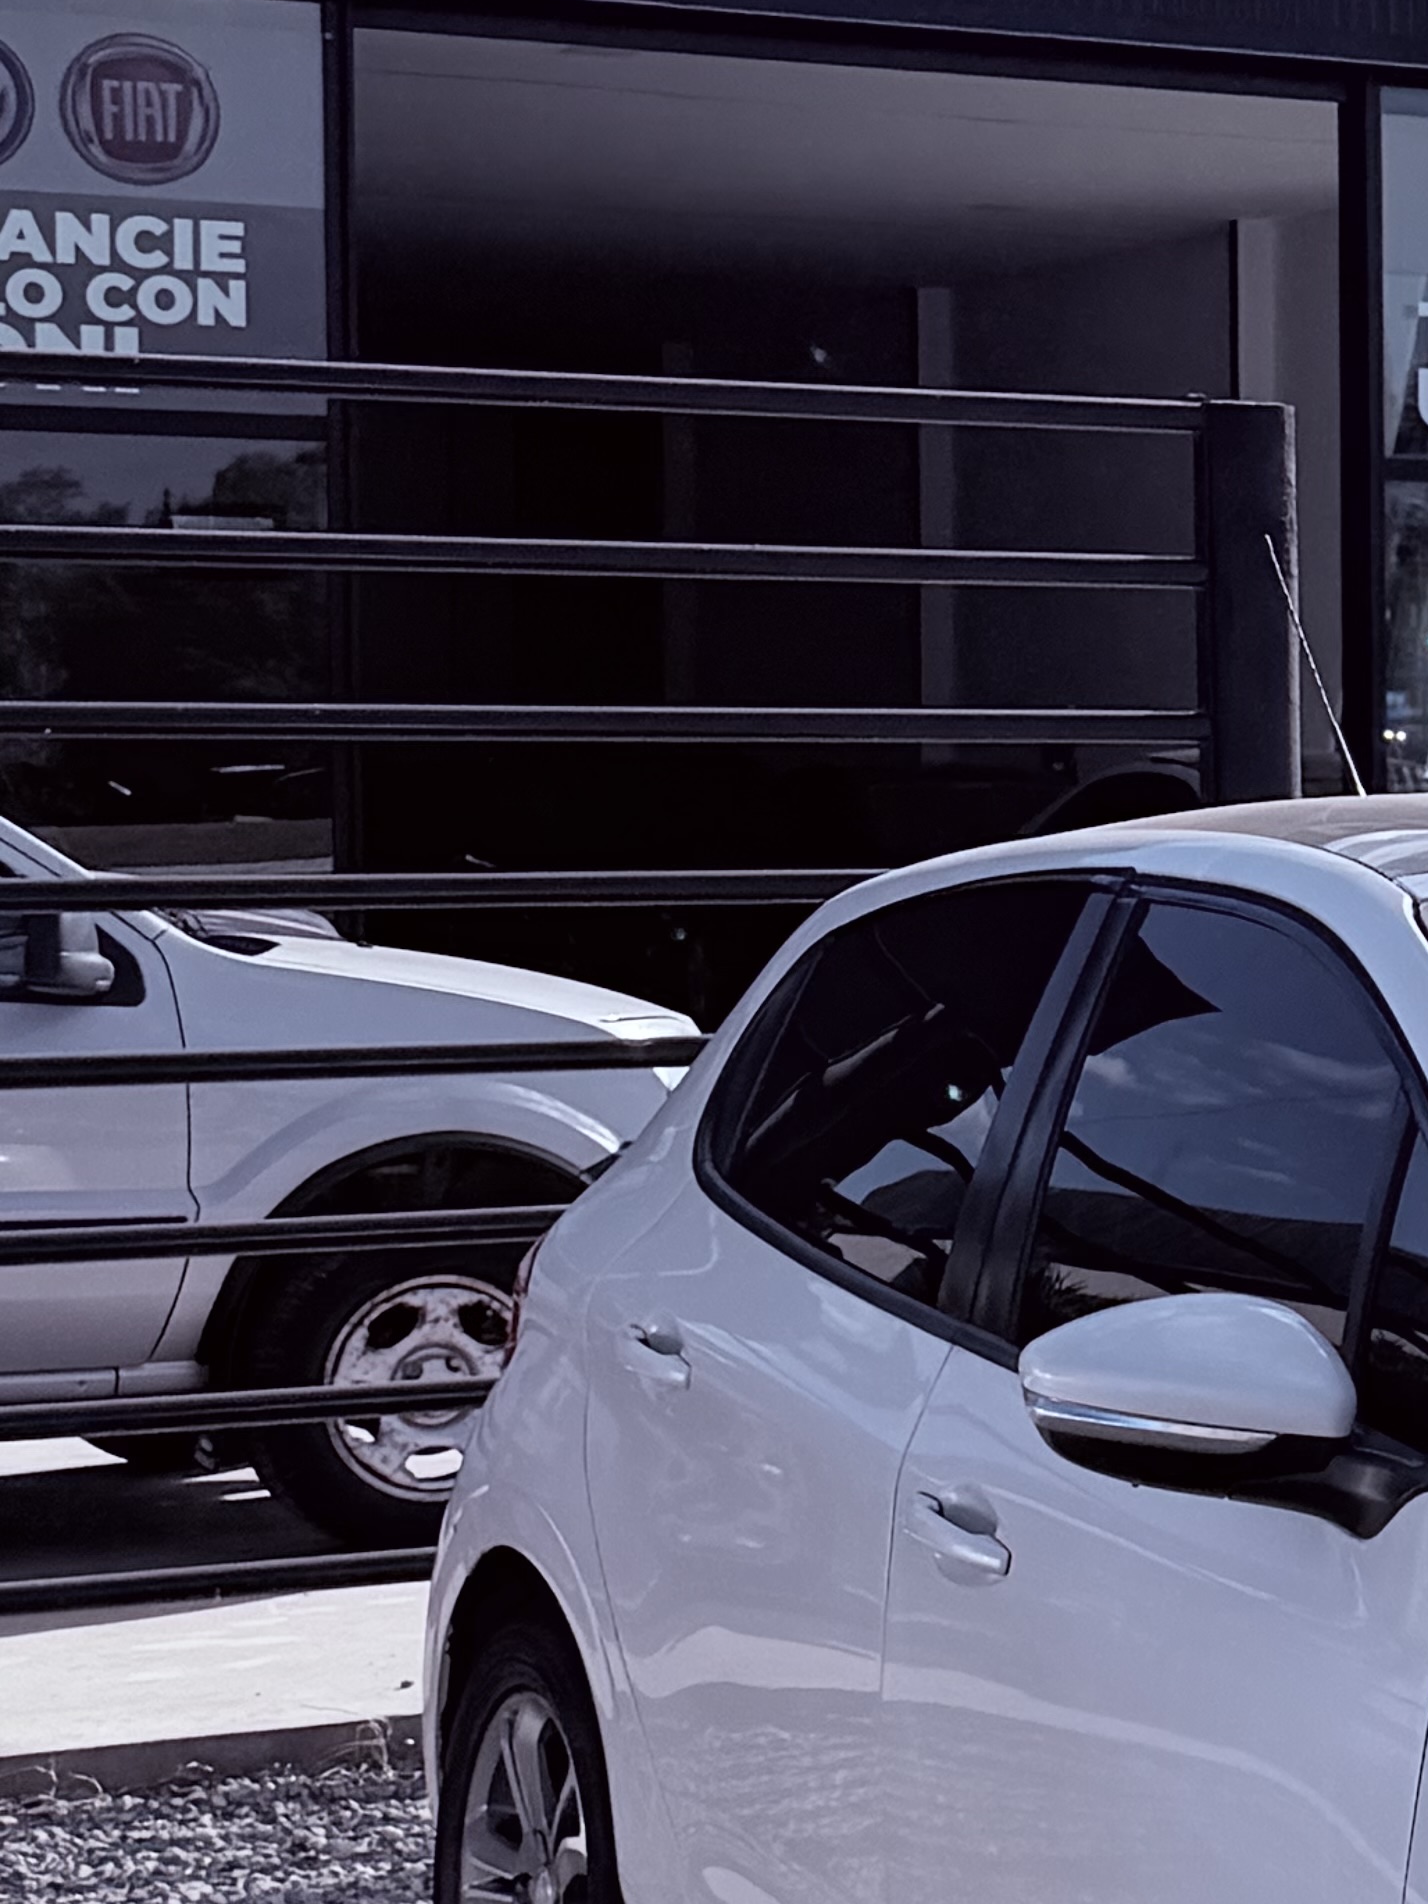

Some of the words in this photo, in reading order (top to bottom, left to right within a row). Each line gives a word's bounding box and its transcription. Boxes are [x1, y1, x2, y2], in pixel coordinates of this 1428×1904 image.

[102, 80, 182, 143] FIAT
[0, 267, 64, 318] O
[85, 272, 247, 328] CON
